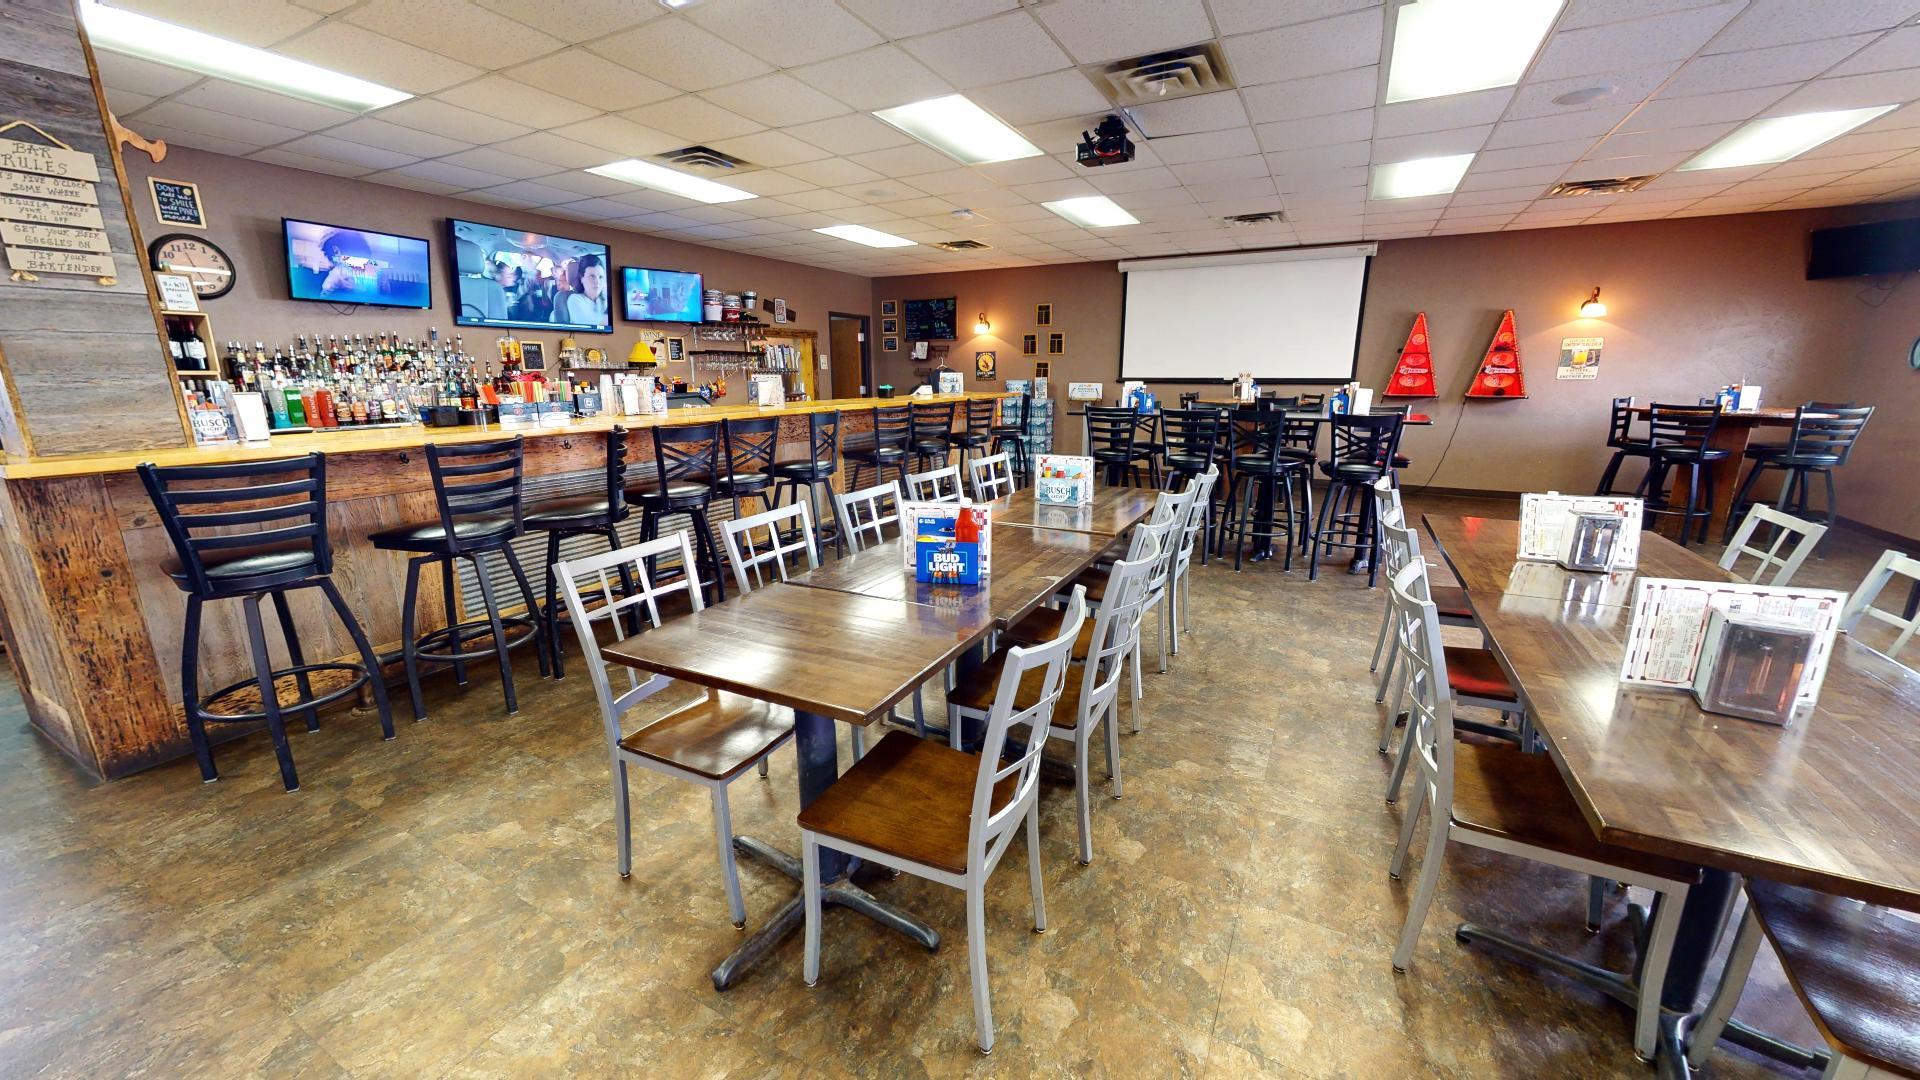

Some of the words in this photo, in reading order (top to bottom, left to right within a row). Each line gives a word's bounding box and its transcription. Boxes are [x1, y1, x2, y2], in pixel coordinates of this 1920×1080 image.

[12, 143, 52, 158] BAR
[1, 153, 68, 175] RULES
[23, 175, 46, 184] FIVE
[10, 182, 42, 193] SOME
[47, 187, 81, 197] WHERE
[14, 224, 37, 234] GET
[78, 241, 91, 249] ON
[30, 250, 54, 260] TIP
[27, 260, 102, 273] BARTENDER
[192, 418, 231, 428] BUSCH
[1045, 486, 1071, 496] BUSCH
[933, 552, 960, 563] BUD
[928, 561, 966, 573] LIGHT
